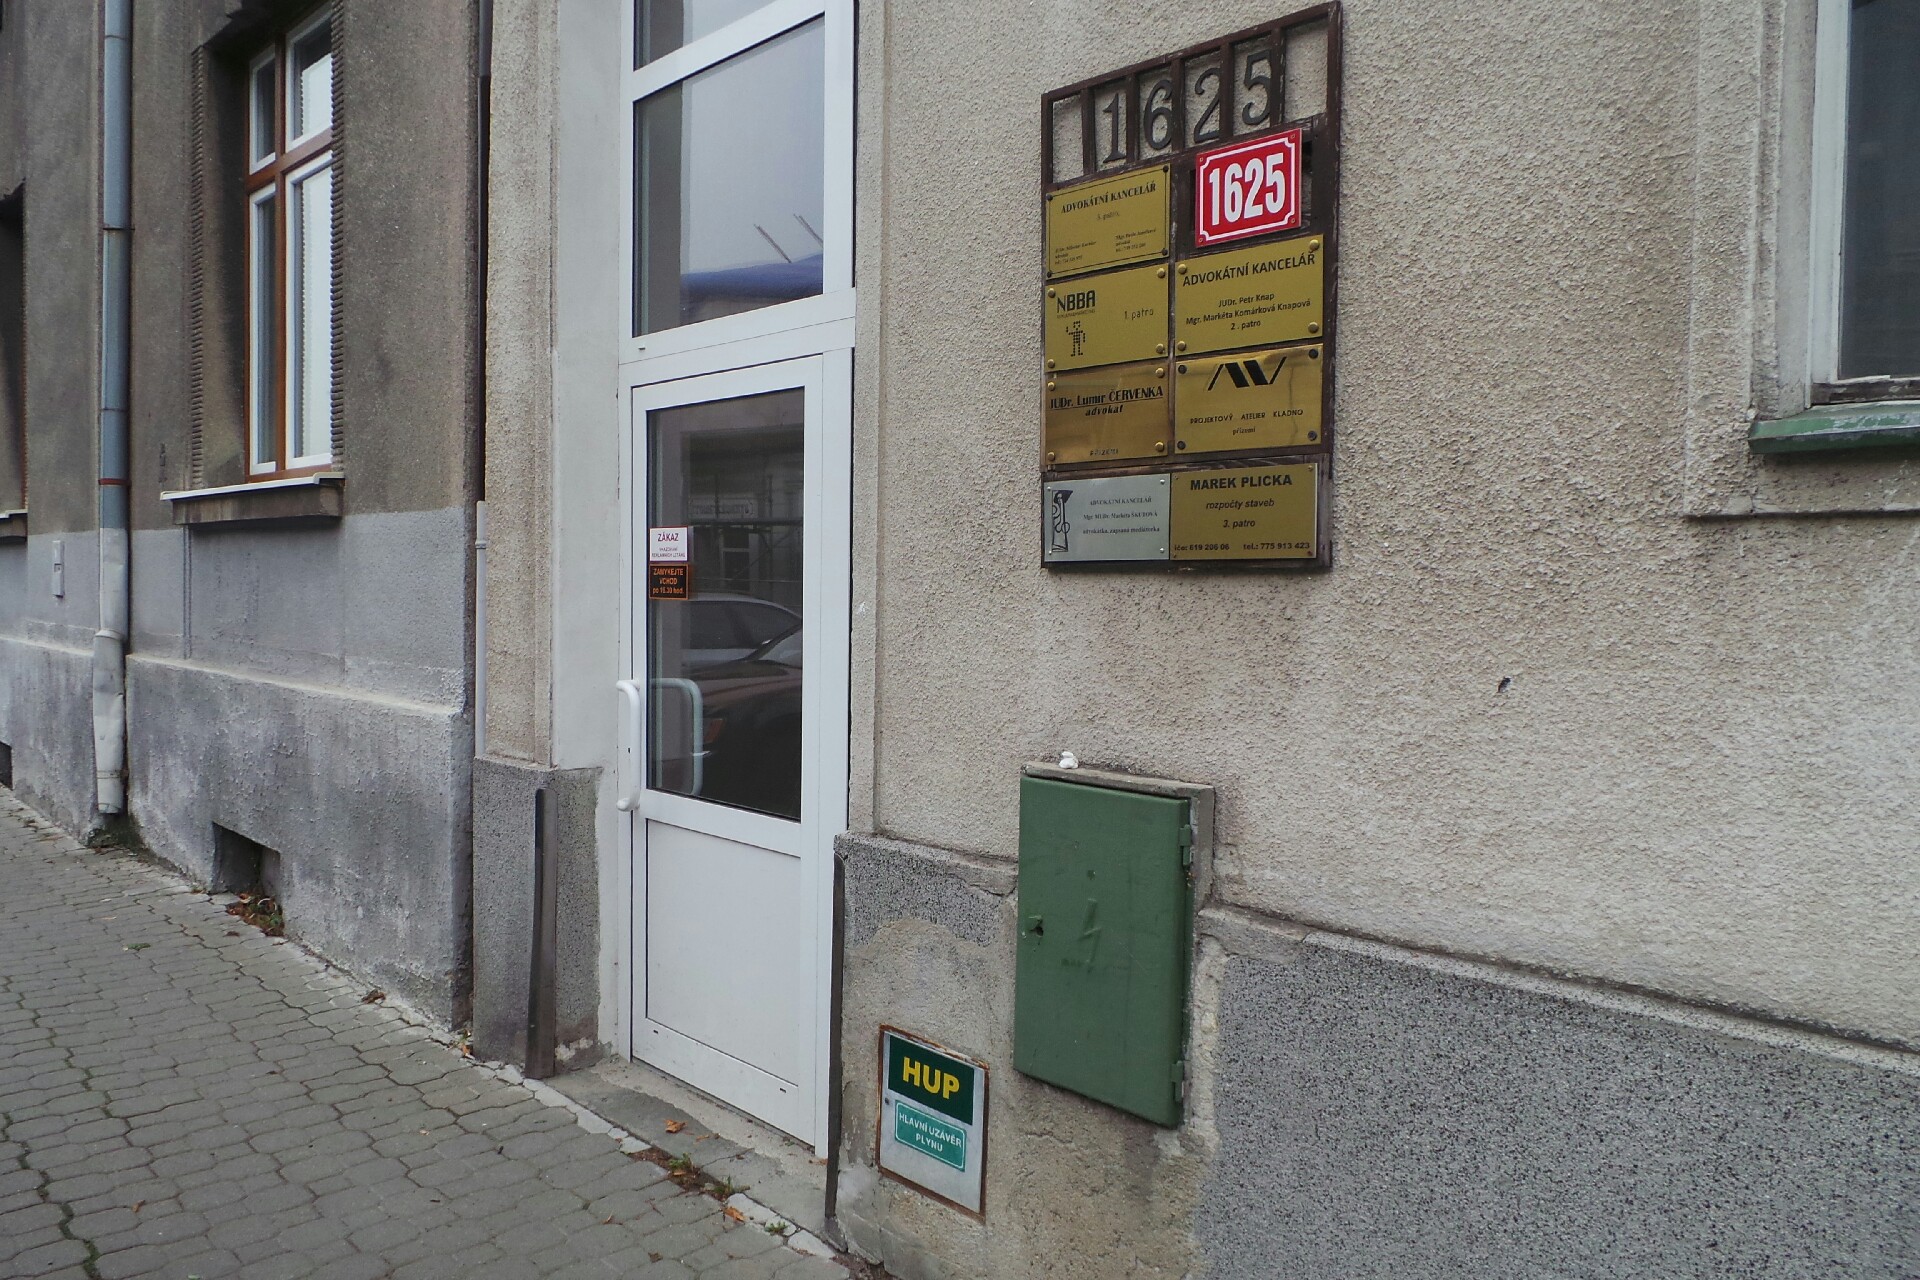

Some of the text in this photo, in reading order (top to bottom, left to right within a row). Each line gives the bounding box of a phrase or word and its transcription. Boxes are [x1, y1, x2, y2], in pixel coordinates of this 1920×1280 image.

[1103, 51, 1272, 163] 1625
[1061, 180, 1156, 214] ADVOKÁTNÍ KANCELÁŘ
[1209, 152, 1286, 226] 1625
[1183, 251, 1315, 287] ADVOKÁTNÍ KANCELÁŘ
[1057, 290, 1096, 313] NBBA
[1218, 293, 1275, 308] JUDr. Petr Knap
[1132, 308, 1154, 320] patro
[1186, 299, 1311, 325] Mgr. Markéta Komárková Knapová
[1241, 320, 1261, 330] patro
[1109, 386, 1164, 402] ČERVENKA
[1190, 408, 1304, 424] PROJEKTOVÝ ATELIER KLADNO
[1190, 474, 1293, 491] MAREK PLICKA
[1205, 498, 1275, 510] rozpočty staveb
[1223, 519, 1256, 530] 3. patro
[657, 532, 679, 541] ZÁKAZ
[1277, 542, 1293, 550] 913
[660, 577, 678, 585] VCHOD
[902, 1056, 960, 1099] HUP
[899, 1112, 928, 1132] HLAVNÍ
[915, 1133, 943, 1152] PLYNU
